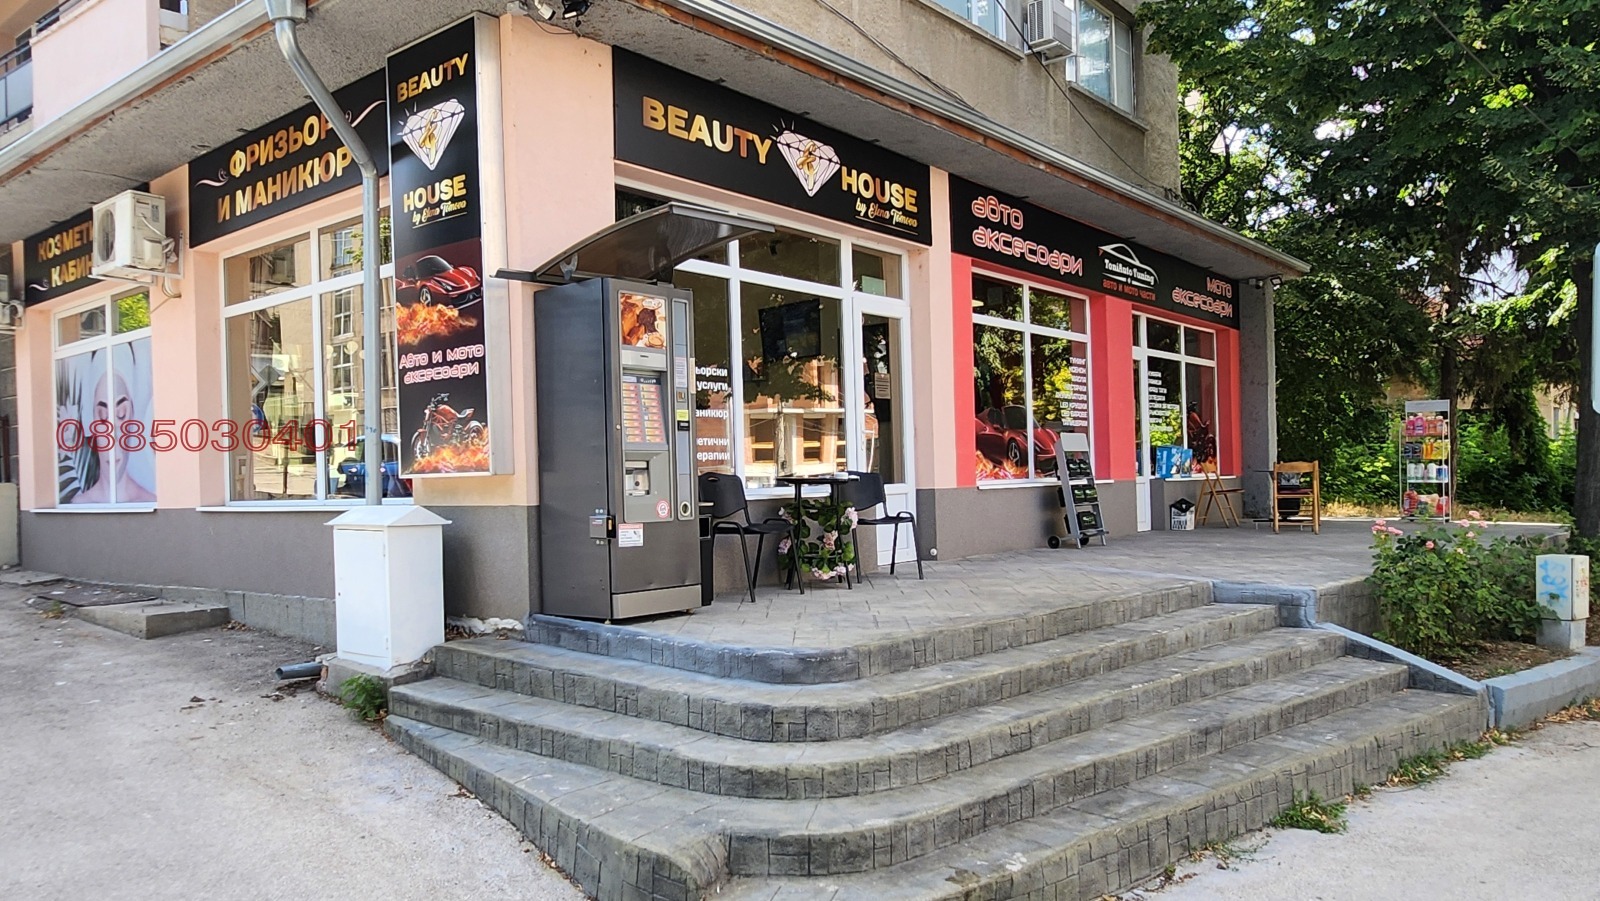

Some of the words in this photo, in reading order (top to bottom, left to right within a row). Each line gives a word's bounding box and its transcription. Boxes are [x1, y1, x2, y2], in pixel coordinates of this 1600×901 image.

[397, 53, 469, 103] BEAUTY
[642, 96, 772, 165] BEAUTY
[229, 112, 333, 178] ФРИЗЬОР
[217, 194, 231, 223] И
[235, 145, 353, 216] МАНИКЮР
[403, 174, 467, 213] HOUSE
[841, 165, 918, 213] HOUSE
[412, 211, 421, 225] by
[855, 197, 867, 216] by
[868, 202, 890, 219] Elena
[972, 226, 1083, 276] аксесоари
[50, 252, 93, 287] КАБИН
[1133, 267, 1155, 286] Tuning
[1172, 286, 1233, 318] аксесоари
[403, 361, 480, 385] аксесоари
[695, 366, 728, 378] ьорски
[696, 380, 729, 392] услуги
[695, 408, 729, 420] аникюр
[697, 437, 730, 447] етични
[697, 451, 731, 462] ерапии
